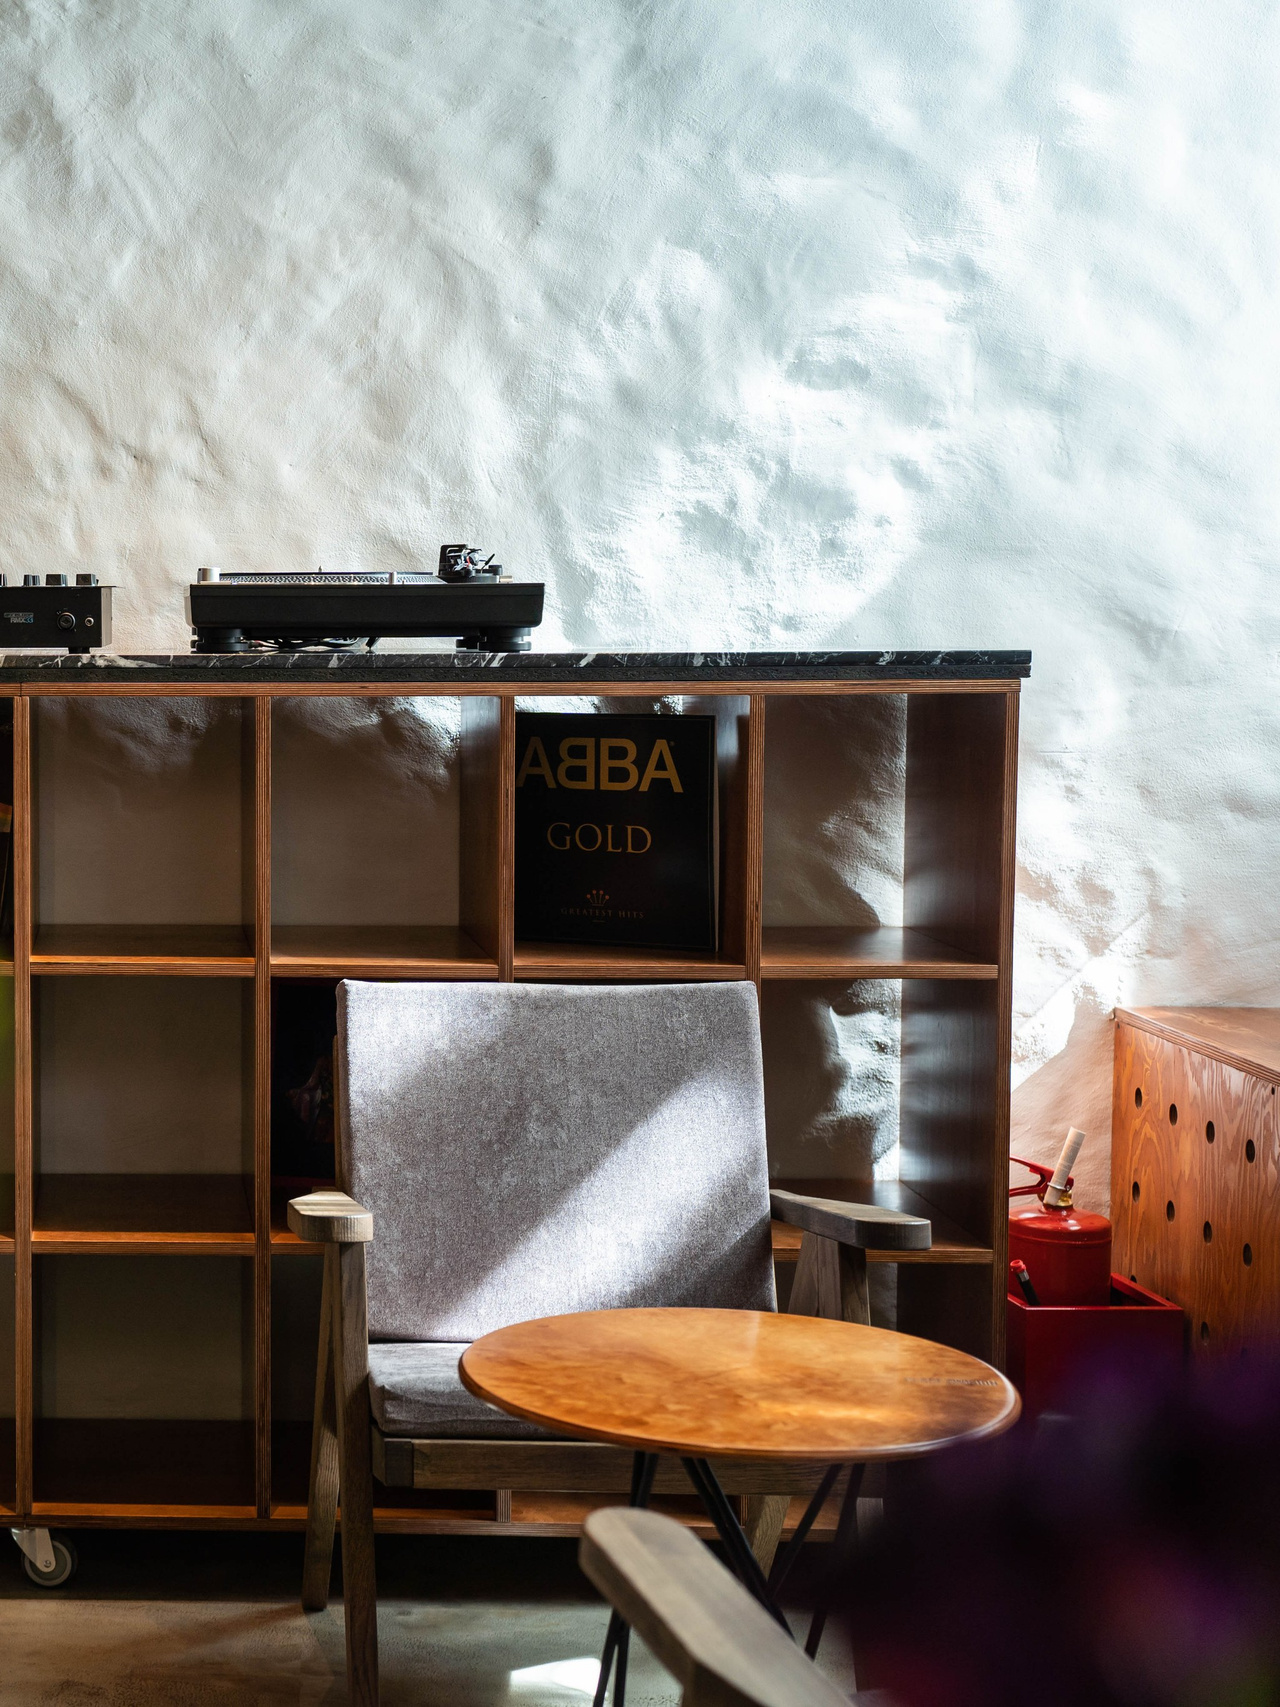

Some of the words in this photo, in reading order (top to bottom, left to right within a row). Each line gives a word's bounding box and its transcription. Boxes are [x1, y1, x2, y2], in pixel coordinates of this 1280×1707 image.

[516, 736, 685, 794] ABBA
[546, 822, 653, 854] GOLD
[560, 907, 613, 918] GREATEST
[618, 909, 646, 919] HITS
